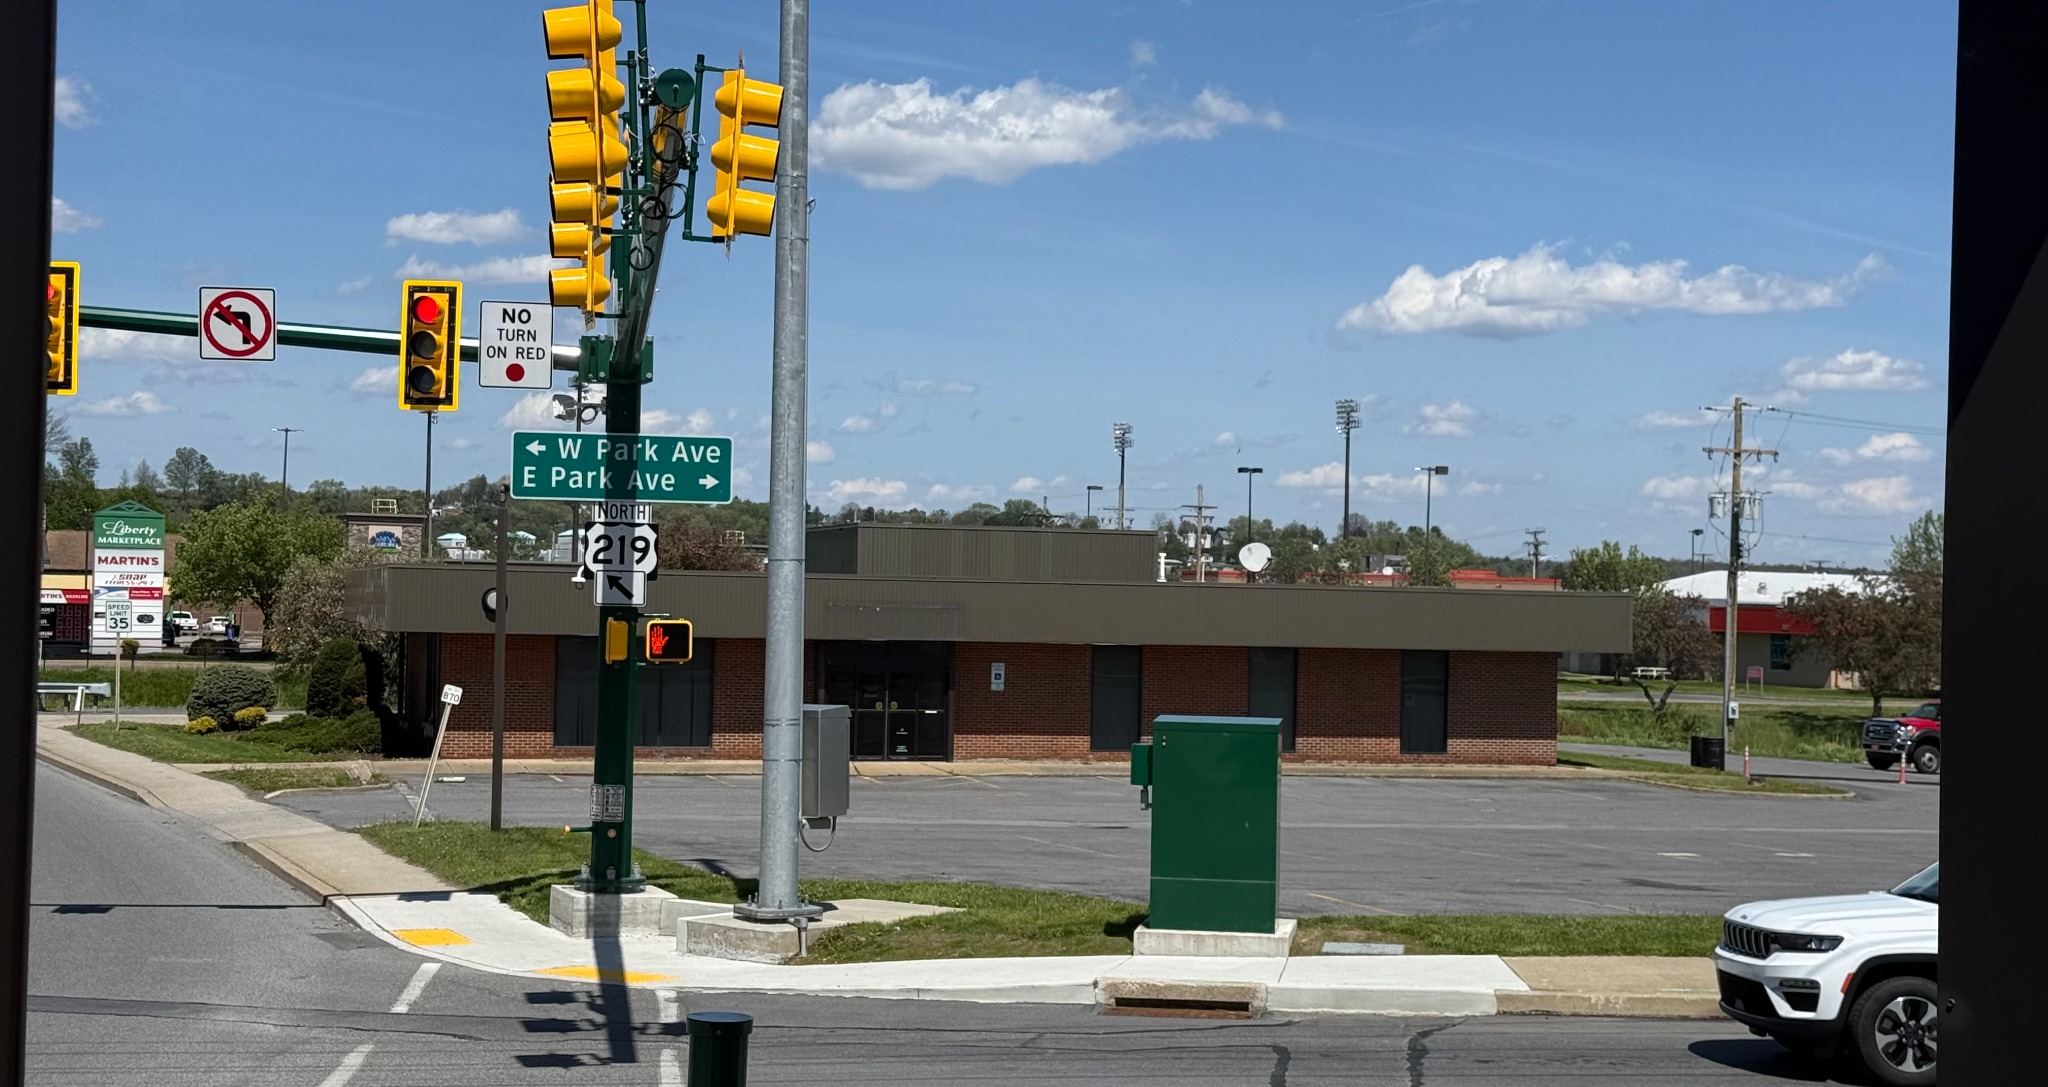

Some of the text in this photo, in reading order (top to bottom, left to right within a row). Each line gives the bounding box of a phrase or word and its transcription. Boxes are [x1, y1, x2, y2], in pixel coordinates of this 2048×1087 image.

[502, 308, 532, 325] NO
[496, 328, 537, 342] TURN
[486, 345, 546, 360] ON RED
[558, 438, 721, 463] W Park Ave
[523, 466, 676, 492] E Park Ave
[598, 501, 646, 520] NORTH
[102, 520, 157, 536] Liberty
[97, 536, 162, 545] MARKETPLACE
[592, 535, 652, 565] 219
[97, 556, 159, 566] MARTIN'S
[109, 618, 129, 629] 35
[443, 692, 460, 702] 870
